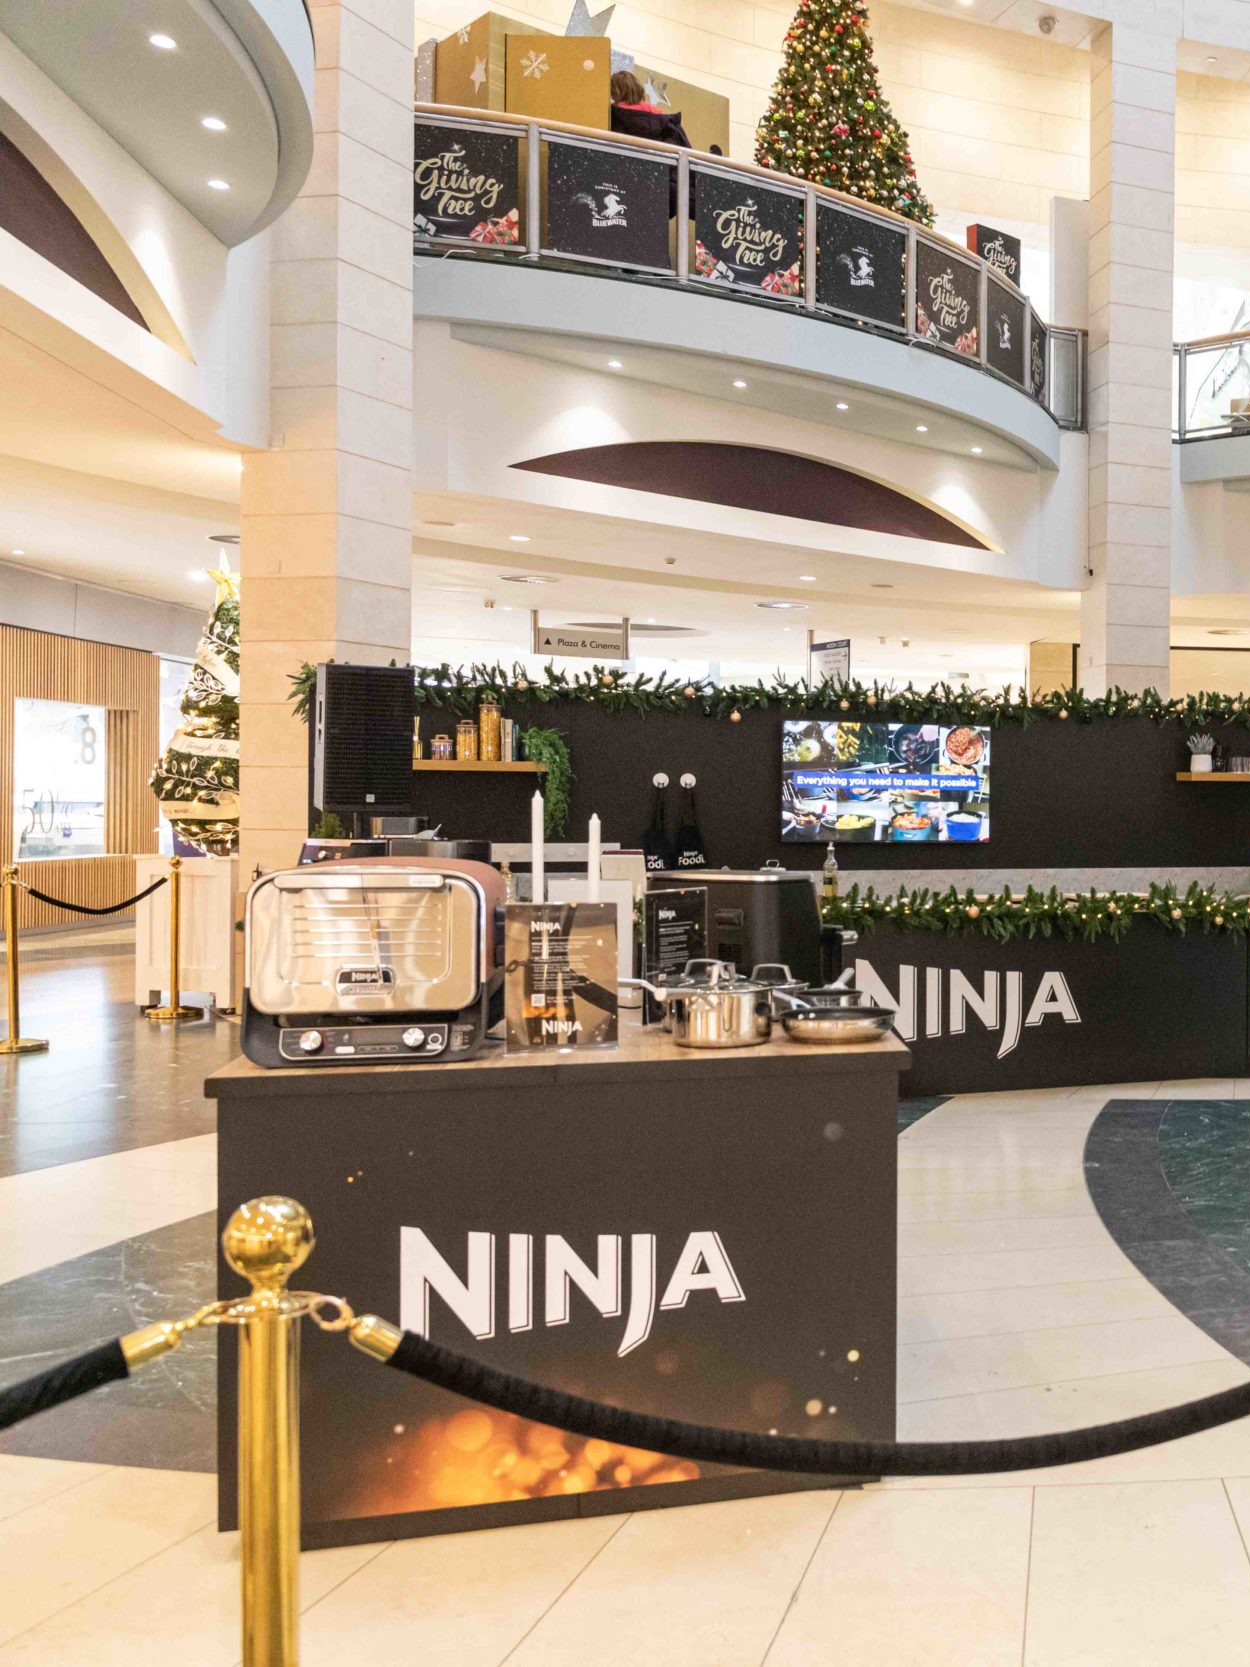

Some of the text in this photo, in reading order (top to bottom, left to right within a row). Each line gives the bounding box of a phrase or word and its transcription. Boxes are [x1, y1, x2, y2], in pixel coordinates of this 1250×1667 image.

[438, 150, 466, 171] The
[413, 158, 504, 209] Giving
[435, 189, 476, 217] Tree
[592, 218, 628, 228] BLUEWATER
[736, 205, 758, 224] The
[713, 210, 788, 262] Giving
[733, 240, 766, 267] Tree
[940, 273, 954, 290] The
[928, 276, 971, 325] Giving
[940, 305, 958, 329] Tree
[557, 638, 620, 651] Plaza & Cinema
[797, 776, 976, 788] Everything you need to make it possible
[647, 860, 665, 869] odi
[678, 854, 704, 866] Foodi
[531, 921, 561, 933] NINJA
[351, 971, 379, 983] NINJA
[855, 958, 1082, 1060] NINJA
[541, 1019, 583, 1036] NINJA
[400, 1225, 747, 1358] NINJA
